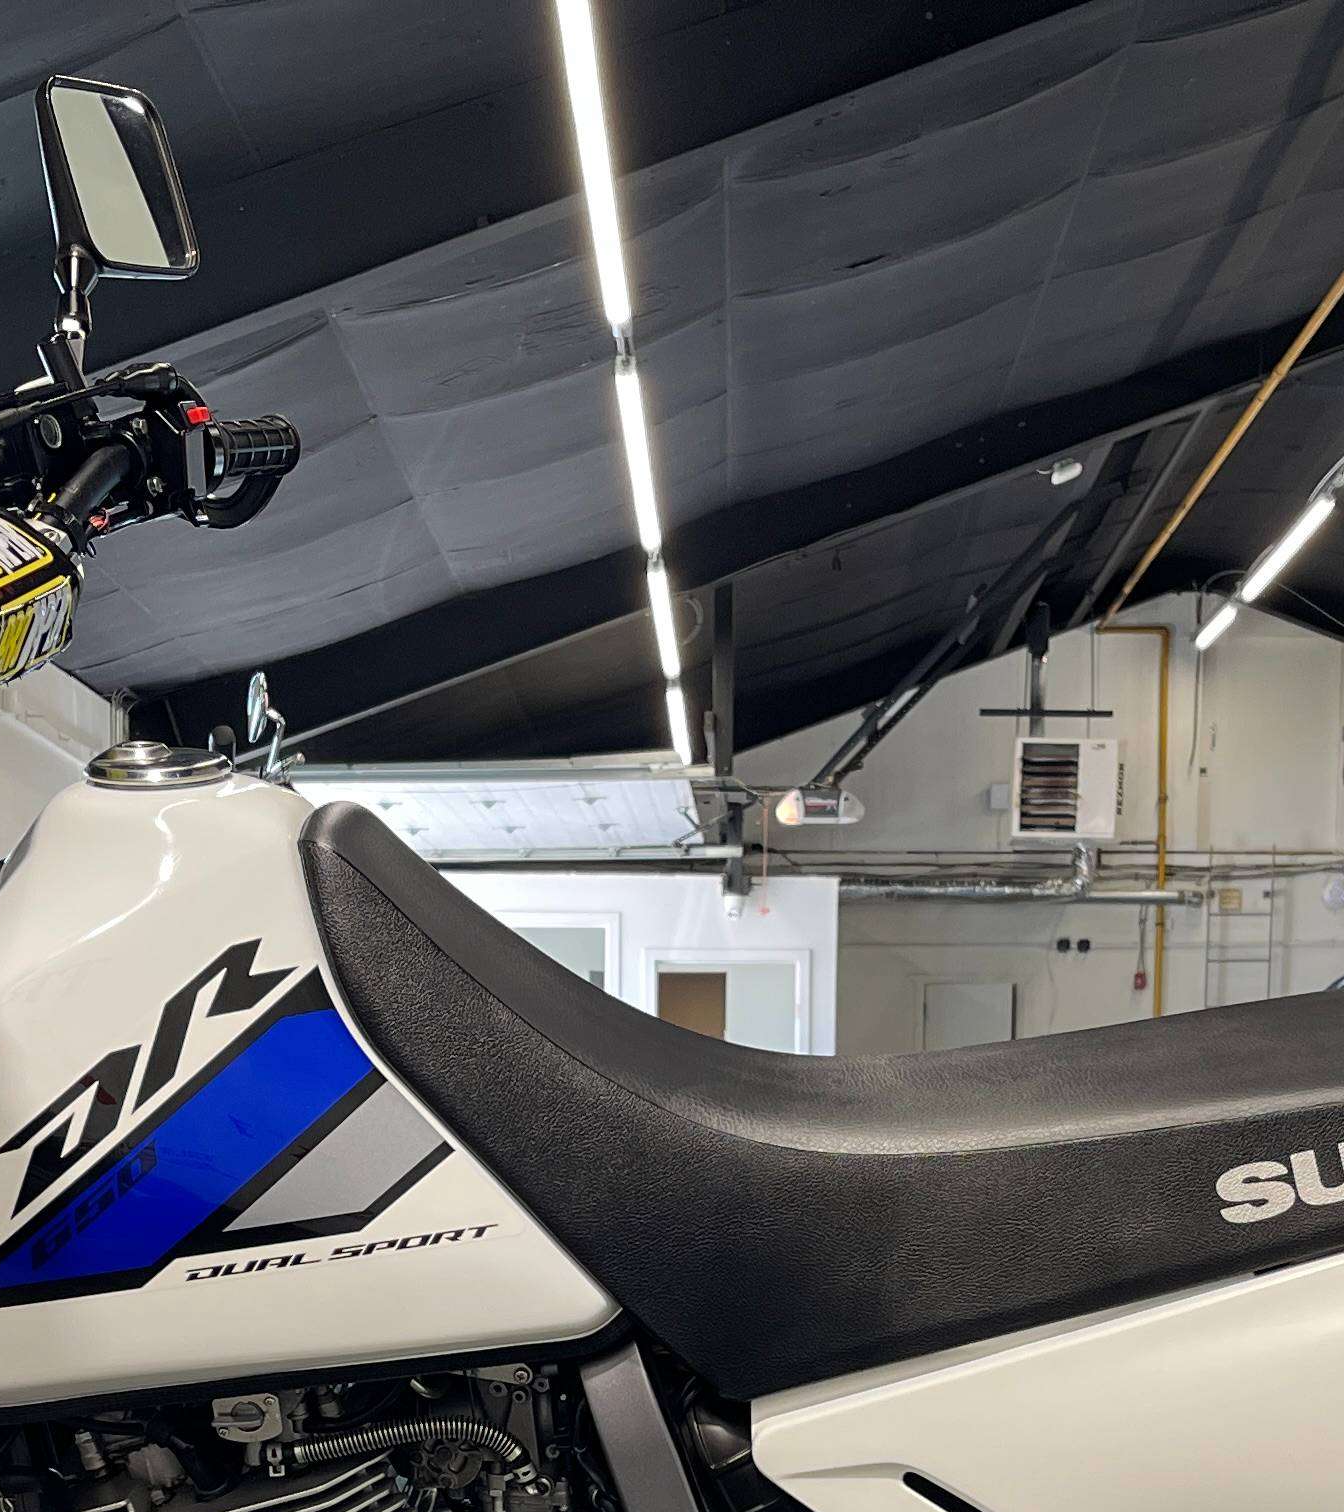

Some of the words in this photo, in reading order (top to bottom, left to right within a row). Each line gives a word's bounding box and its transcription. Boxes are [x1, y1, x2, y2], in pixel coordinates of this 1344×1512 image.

[30, 1140, 159, 1270] 650
[185, 1252, 323, 1282] DUAL
[328, 1223, 499, 1265] SPORT
